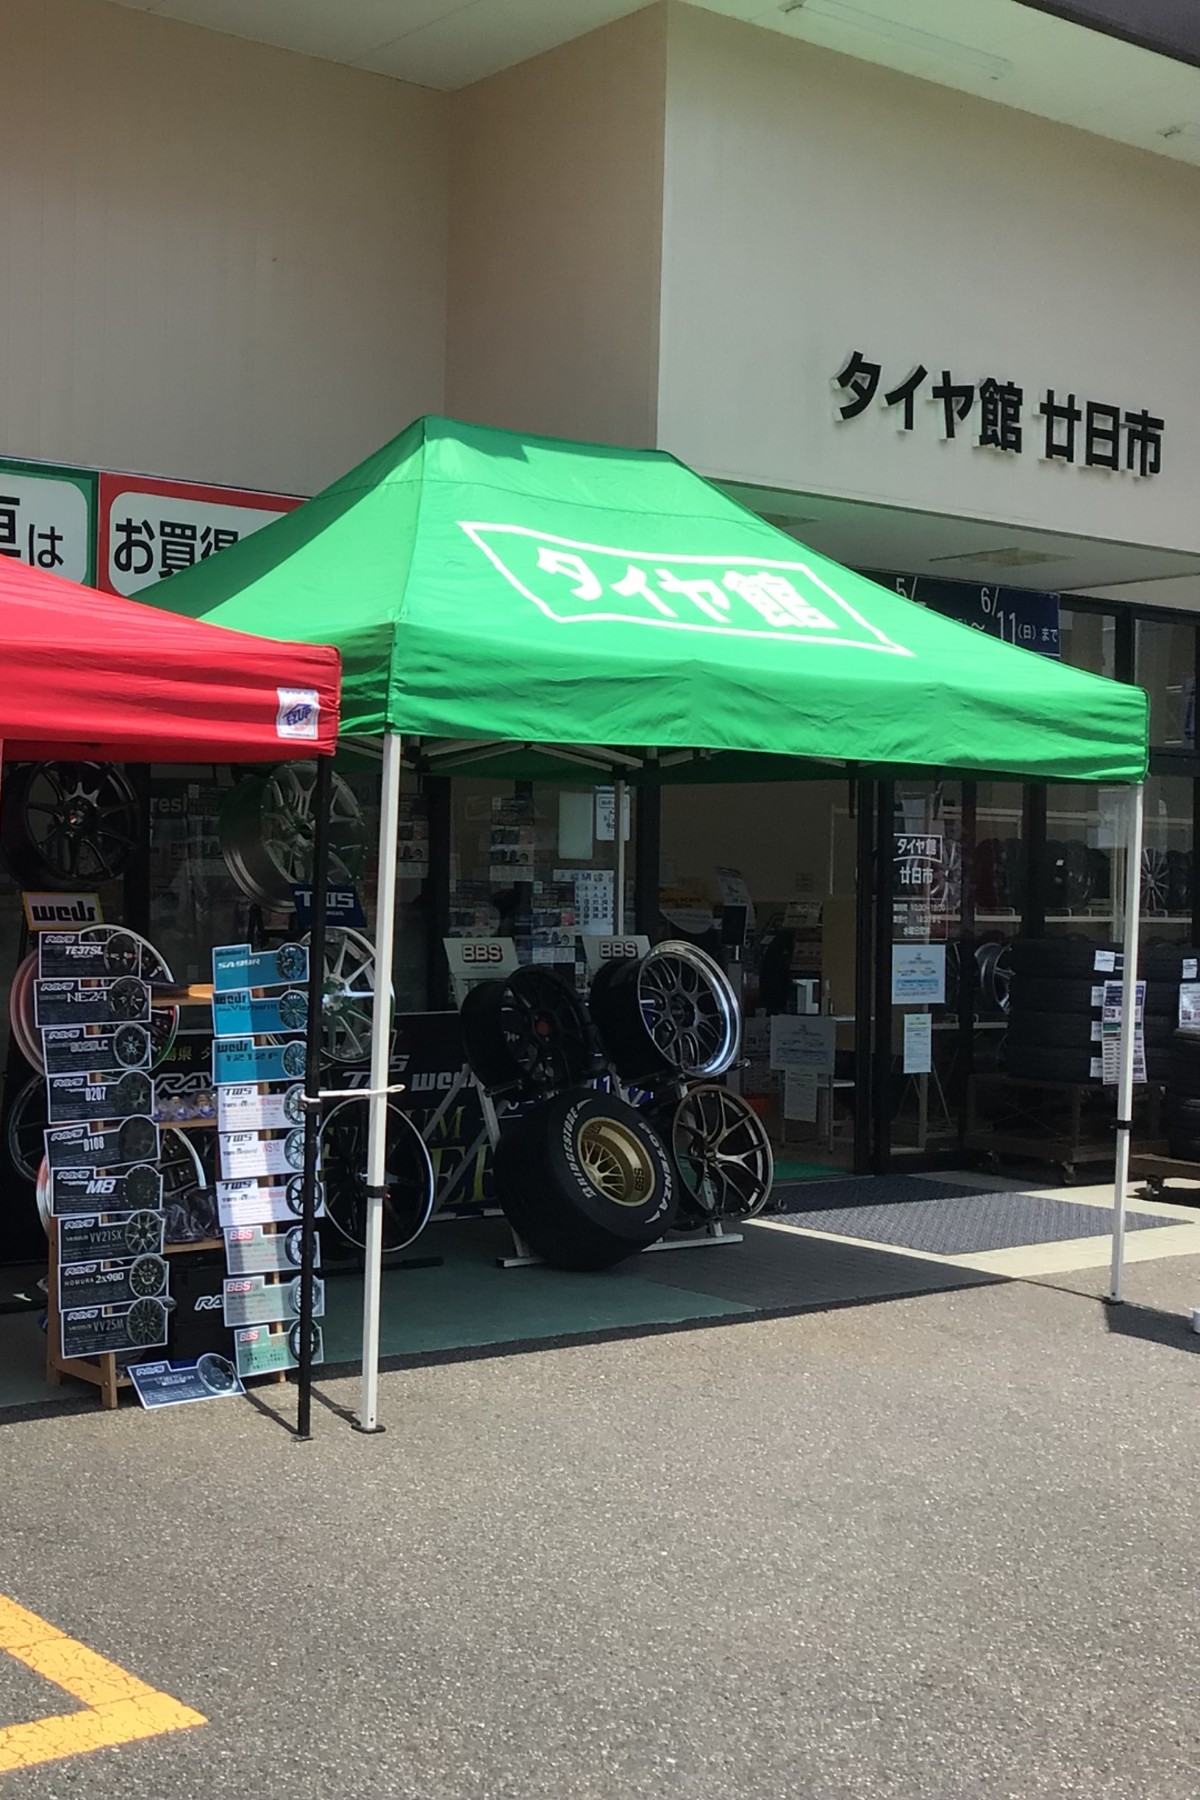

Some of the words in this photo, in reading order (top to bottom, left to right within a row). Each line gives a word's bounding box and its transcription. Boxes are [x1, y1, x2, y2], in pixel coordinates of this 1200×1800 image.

[832, 350, 1024, 454] タイヤ館
[1038, 388, 1165, 477] 廿日市
[536, 546, 841, 630] タイヤ館
[897, 838, 937, 855] タイヤ館
[900, 866, 934, 885] 廿日市
[462, 943, 503, 963] BBS
[600, 941, 638, 960] BBS
[638, 1121, 673, 1211] POTENZA
[86, 1179, 117, 1195] M8
[221, 1180, 252, 1190] TWS
[229, 1229, 254, 1242] BBS
[226, 1281, 252, 1293] BBS
[240, 1330, 260, 1344] BBS
